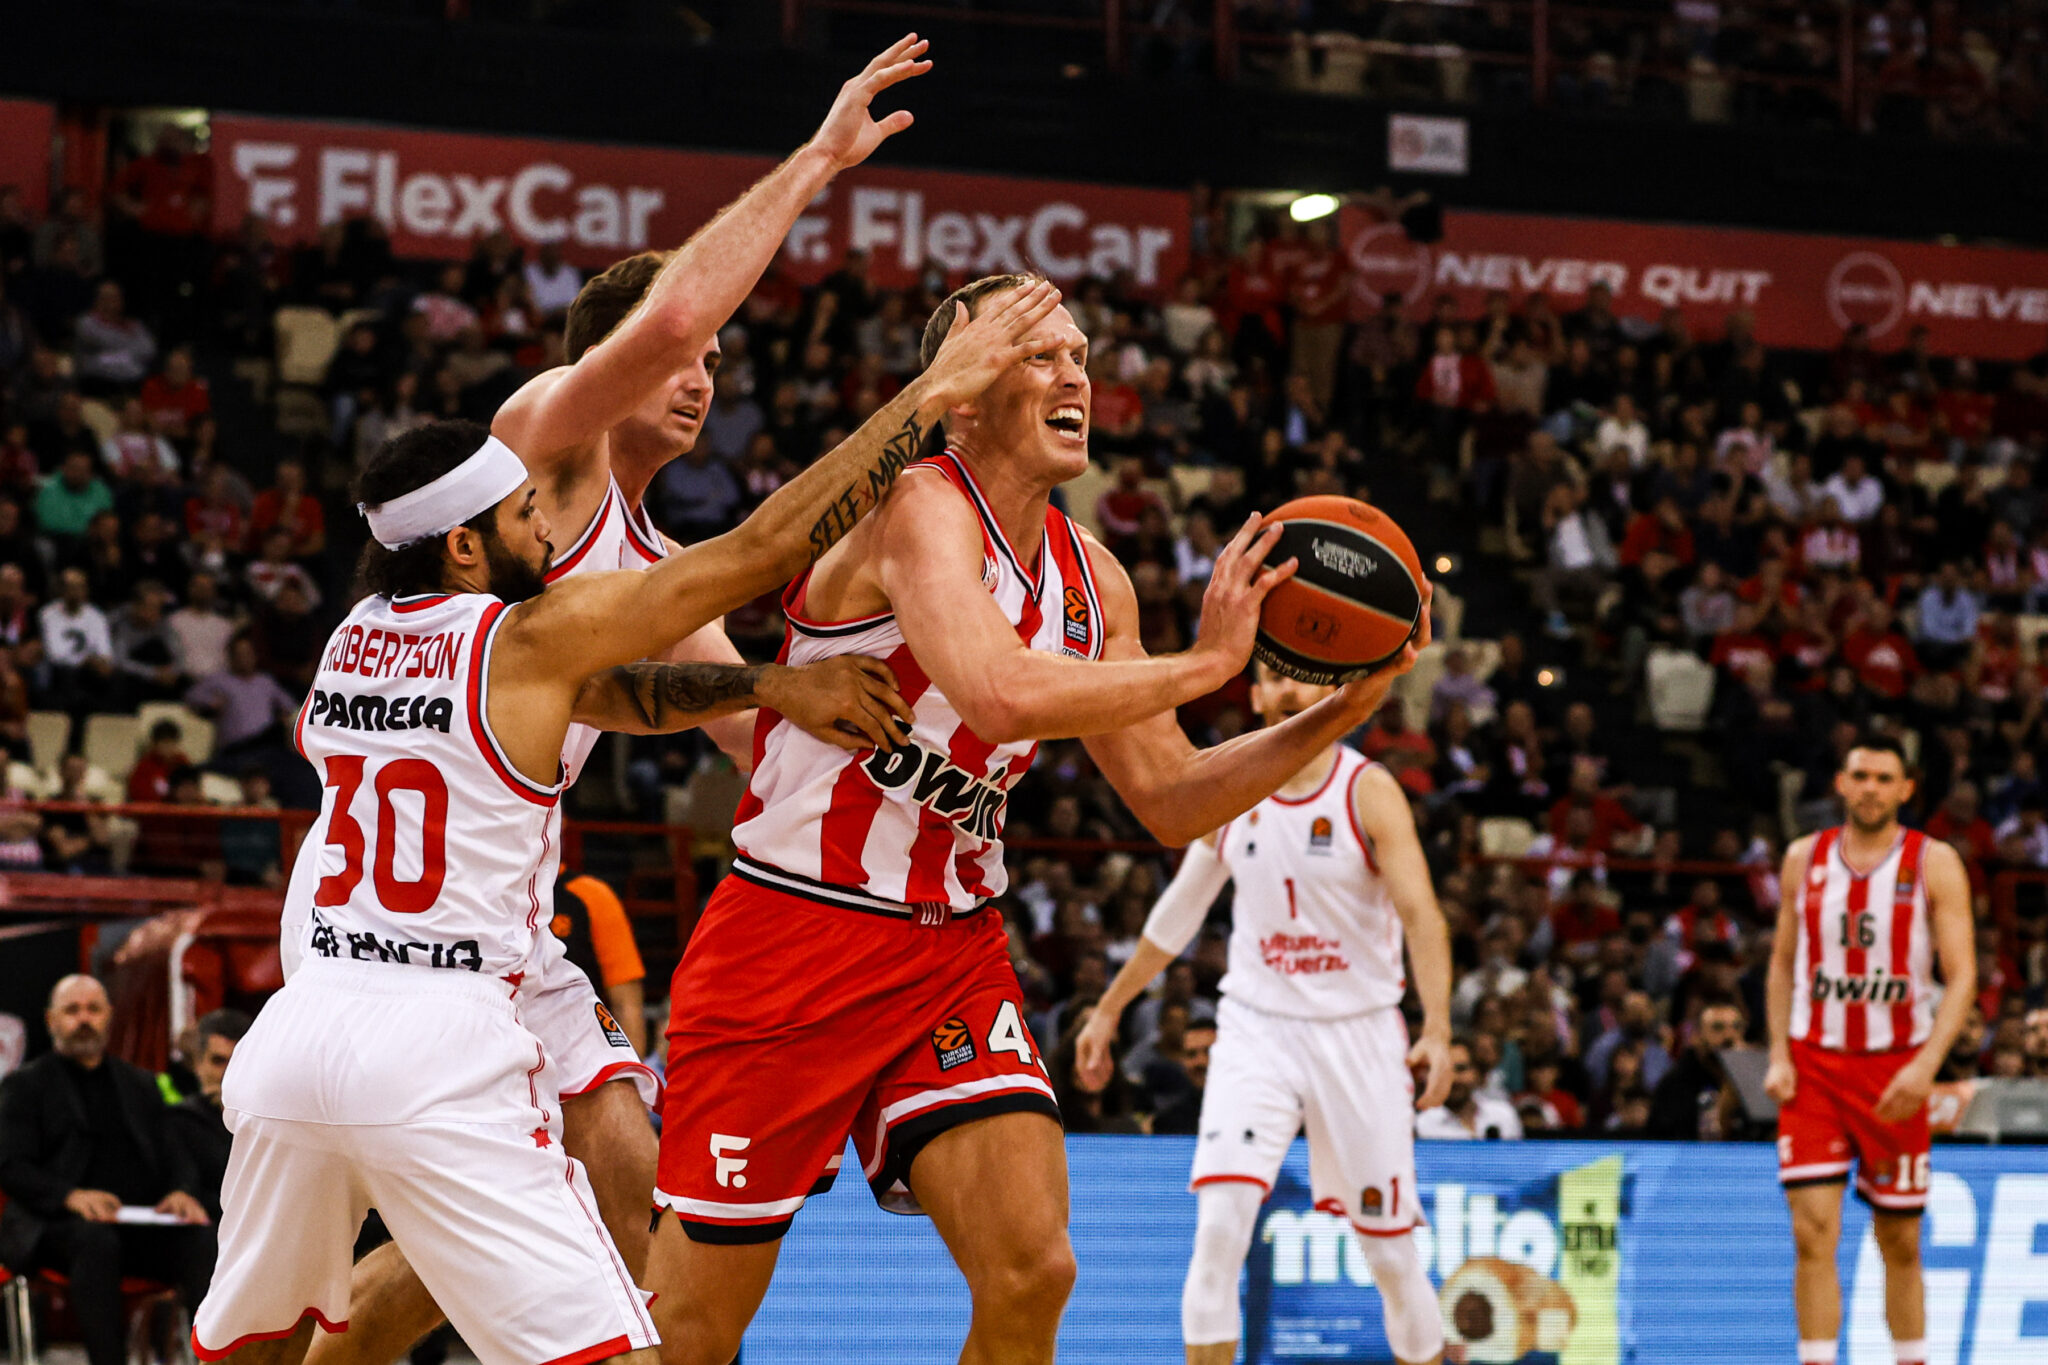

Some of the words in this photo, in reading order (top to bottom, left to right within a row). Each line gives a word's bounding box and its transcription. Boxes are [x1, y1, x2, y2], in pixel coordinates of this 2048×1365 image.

[317, 147, 665, 248] FlexCar
[850, 187, 1174, 286] FlexCar
[1436, 253, 1630, 295] NEVER
[1642, 263, 1773, 308] QUIT
[322, 624, 466, 681] ROBERTSON
[860, 715, 1008, 843] bwin
[314, 754, 449, 914] 30
[1284, 877, 1297, 920] 1
[1840, 912, 1876, 947] 16
[1811, 960, 1909, 1004] bwin
[941, 1044, 971, 1060] TURKISH
[942, 1049, 973, 1065] AIRLINES
[1389, 1175, 1399, 1218] 1
